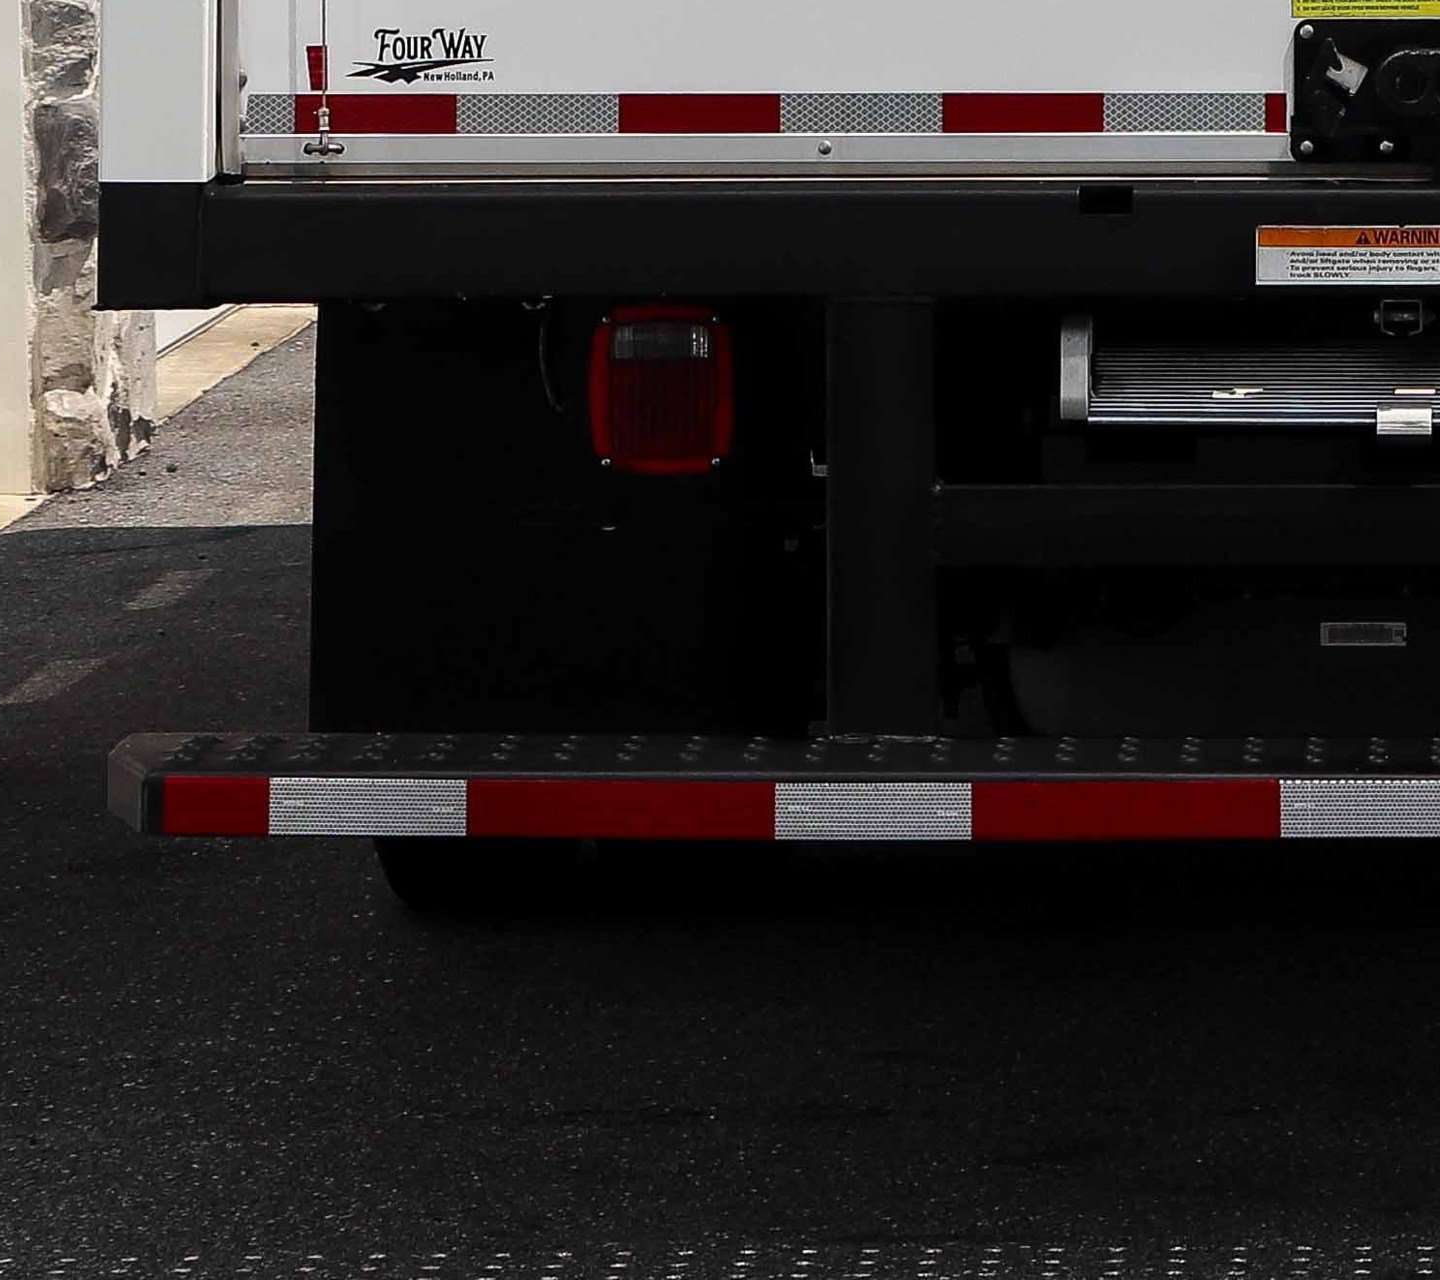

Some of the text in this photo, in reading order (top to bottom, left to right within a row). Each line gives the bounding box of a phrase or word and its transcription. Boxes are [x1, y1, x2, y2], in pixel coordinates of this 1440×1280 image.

[374, 27, 488, 62] FOUR WAY
[424, 71, 494, 82] New Holland, PA
